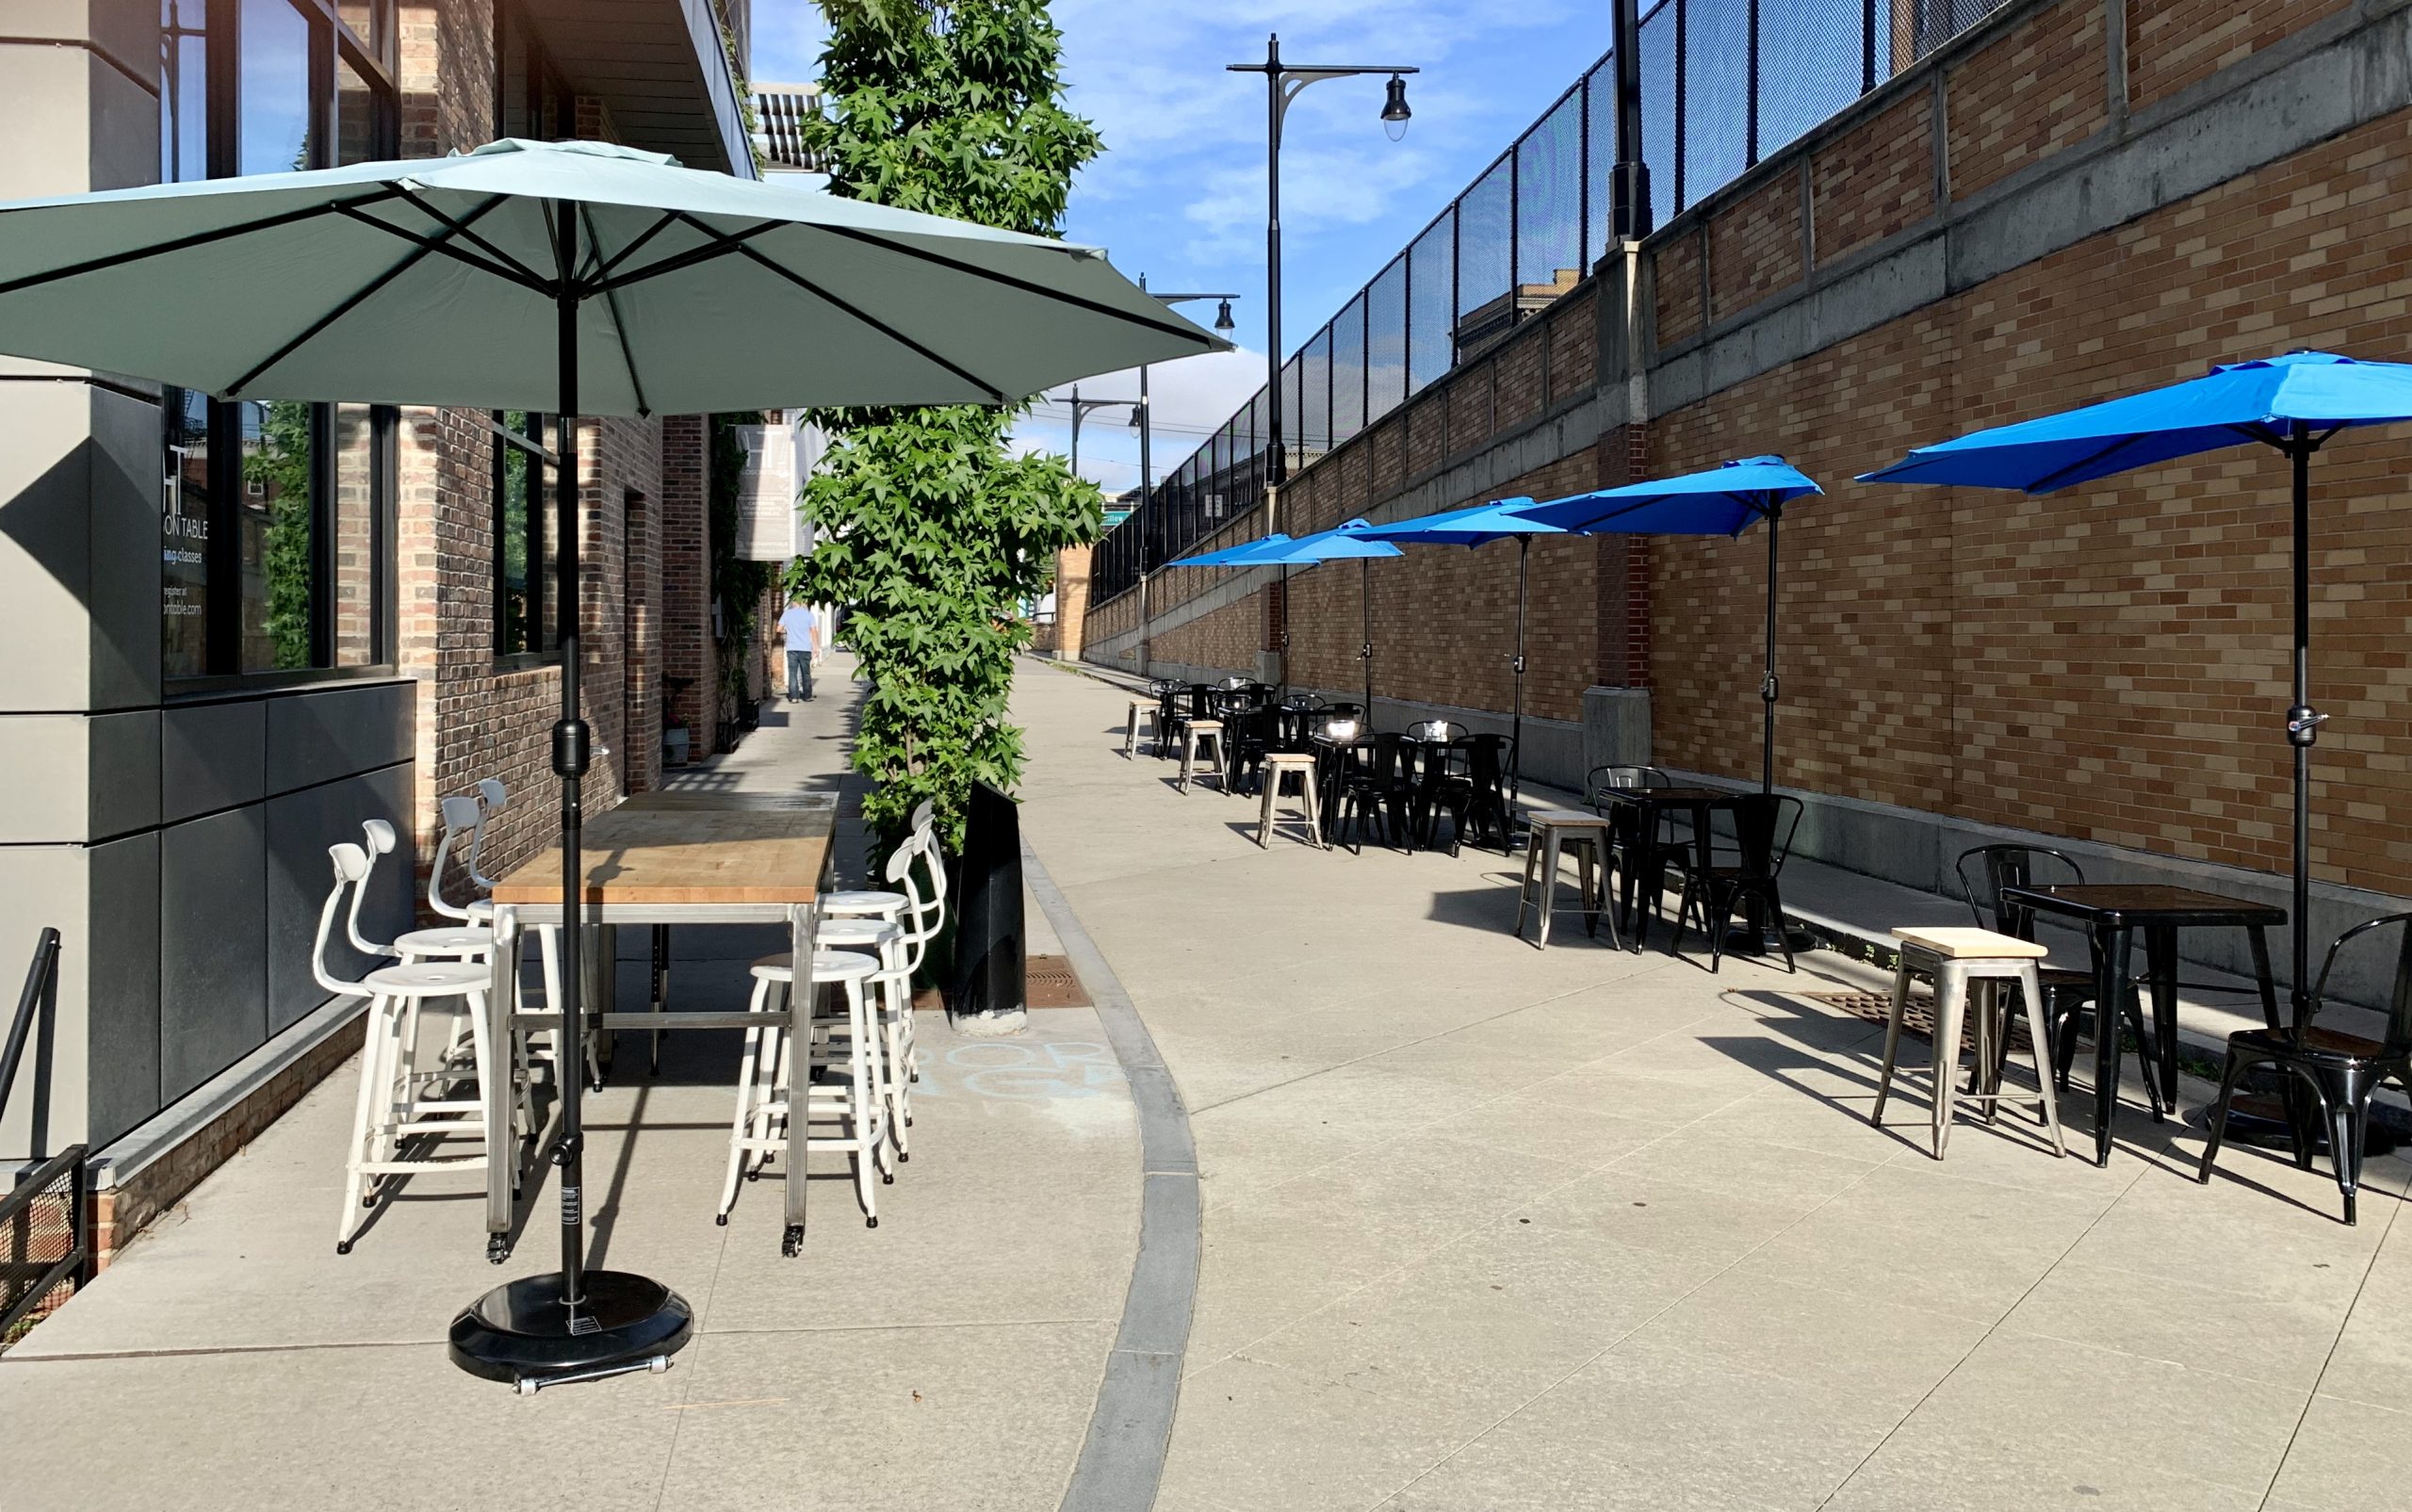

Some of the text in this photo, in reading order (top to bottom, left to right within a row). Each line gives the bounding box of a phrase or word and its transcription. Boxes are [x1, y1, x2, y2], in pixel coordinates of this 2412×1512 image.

[163, 514, 208, 540] ON TABLE
[177, 546, 203, 563] classes
[163, 584, 181, 598] egister
